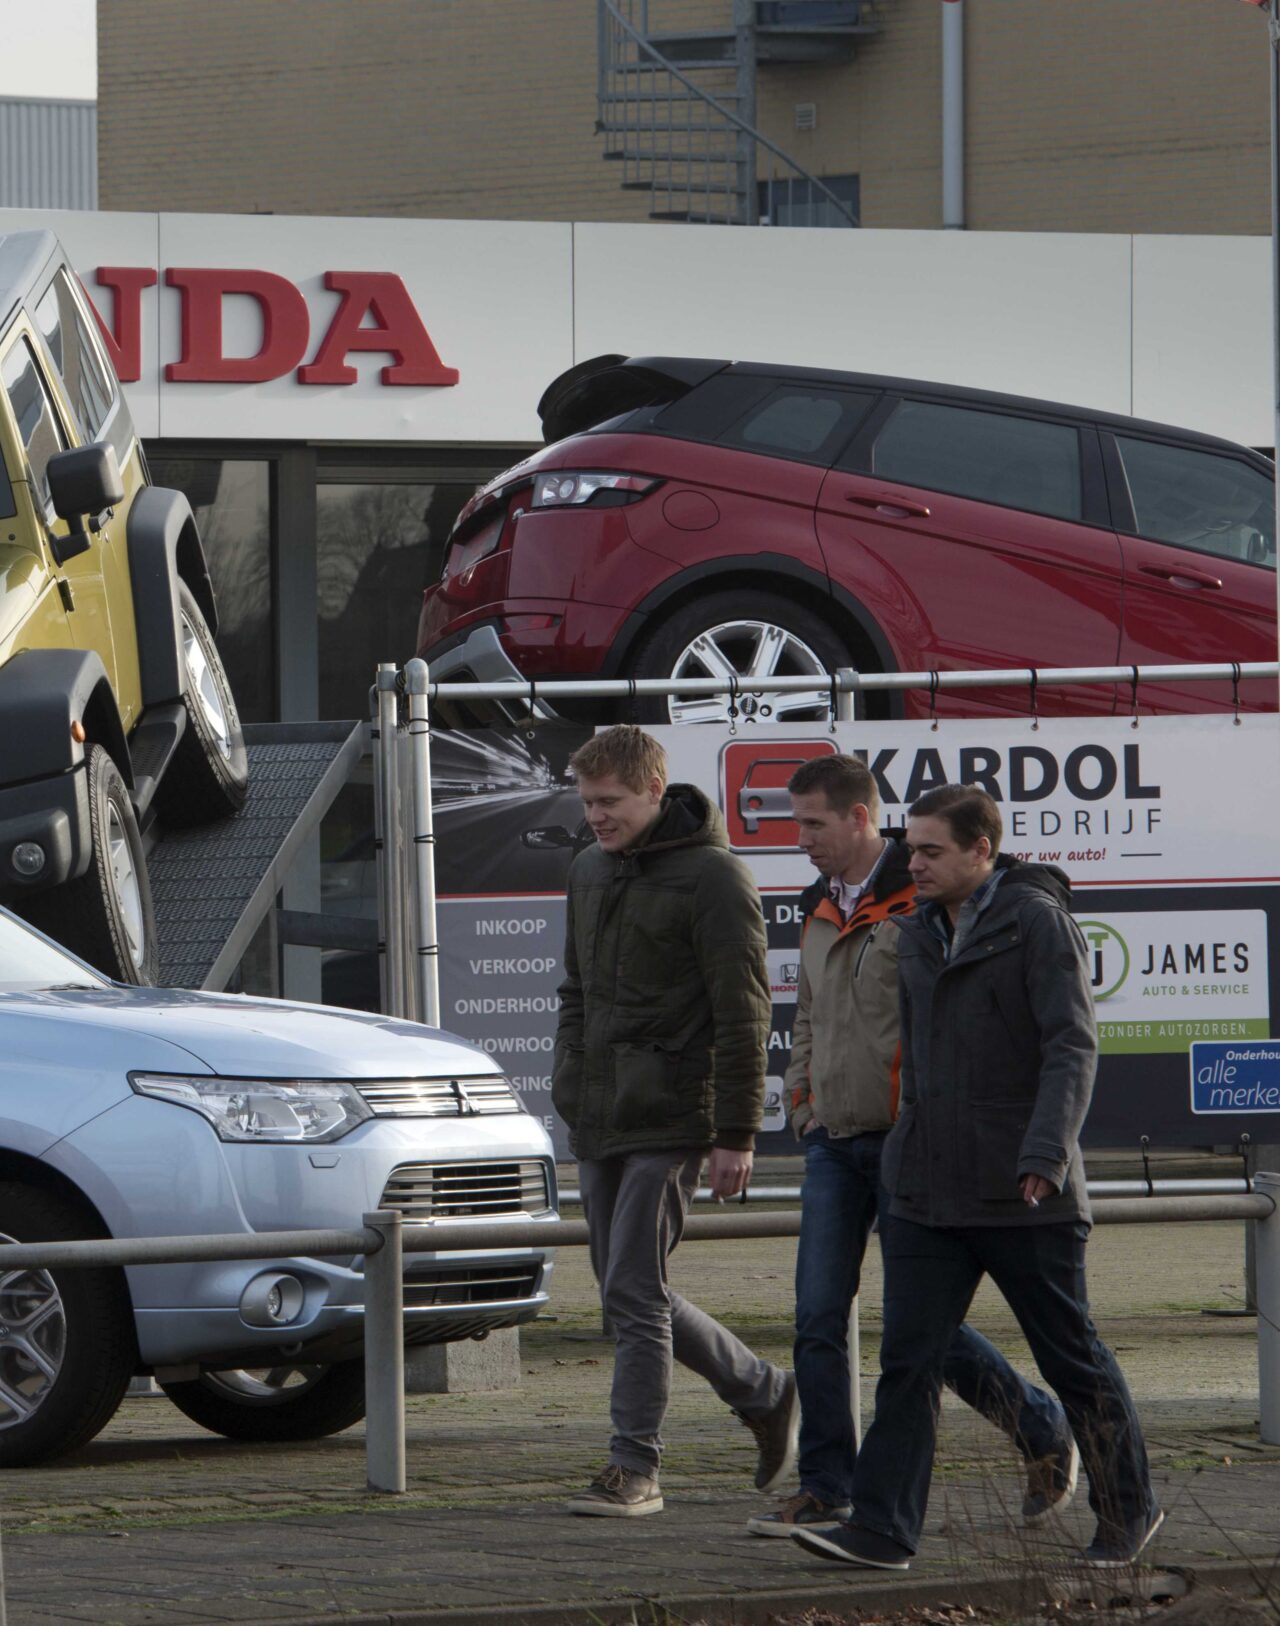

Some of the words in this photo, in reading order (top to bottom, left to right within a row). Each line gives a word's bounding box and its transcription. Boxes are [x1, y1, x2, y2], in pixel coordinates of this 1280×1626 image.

[853, 744, 1161, 804] KARDOL
[1038, 850, 1061, 862] uw
[1067, 847, 1106, 861] auto!
[476, 919, 547, 935] INKOOP
[470, 958, 556, 975] VERKOOP
[1141, 943, 1249, 975] JAMES
[1142, 985, 1177, 996] AUTO
[1181, 985, 1189, 995] &
[1194, 984, 1249, 995] SERVICE
[455, 997, 560, 1014] ONDERHOU
[1100, 1025, 1151, 1038] ZONDER
[1159, 1023, 1252, 1037] AUTOZORGEN.
[470, 1036, 554, 1053] HOWROO
[1225, 1050, 1280, 1060] Onderhou
[1198, 1060, 1237, 1084] alle
[1210, 1081, 1280, 1106] merke
